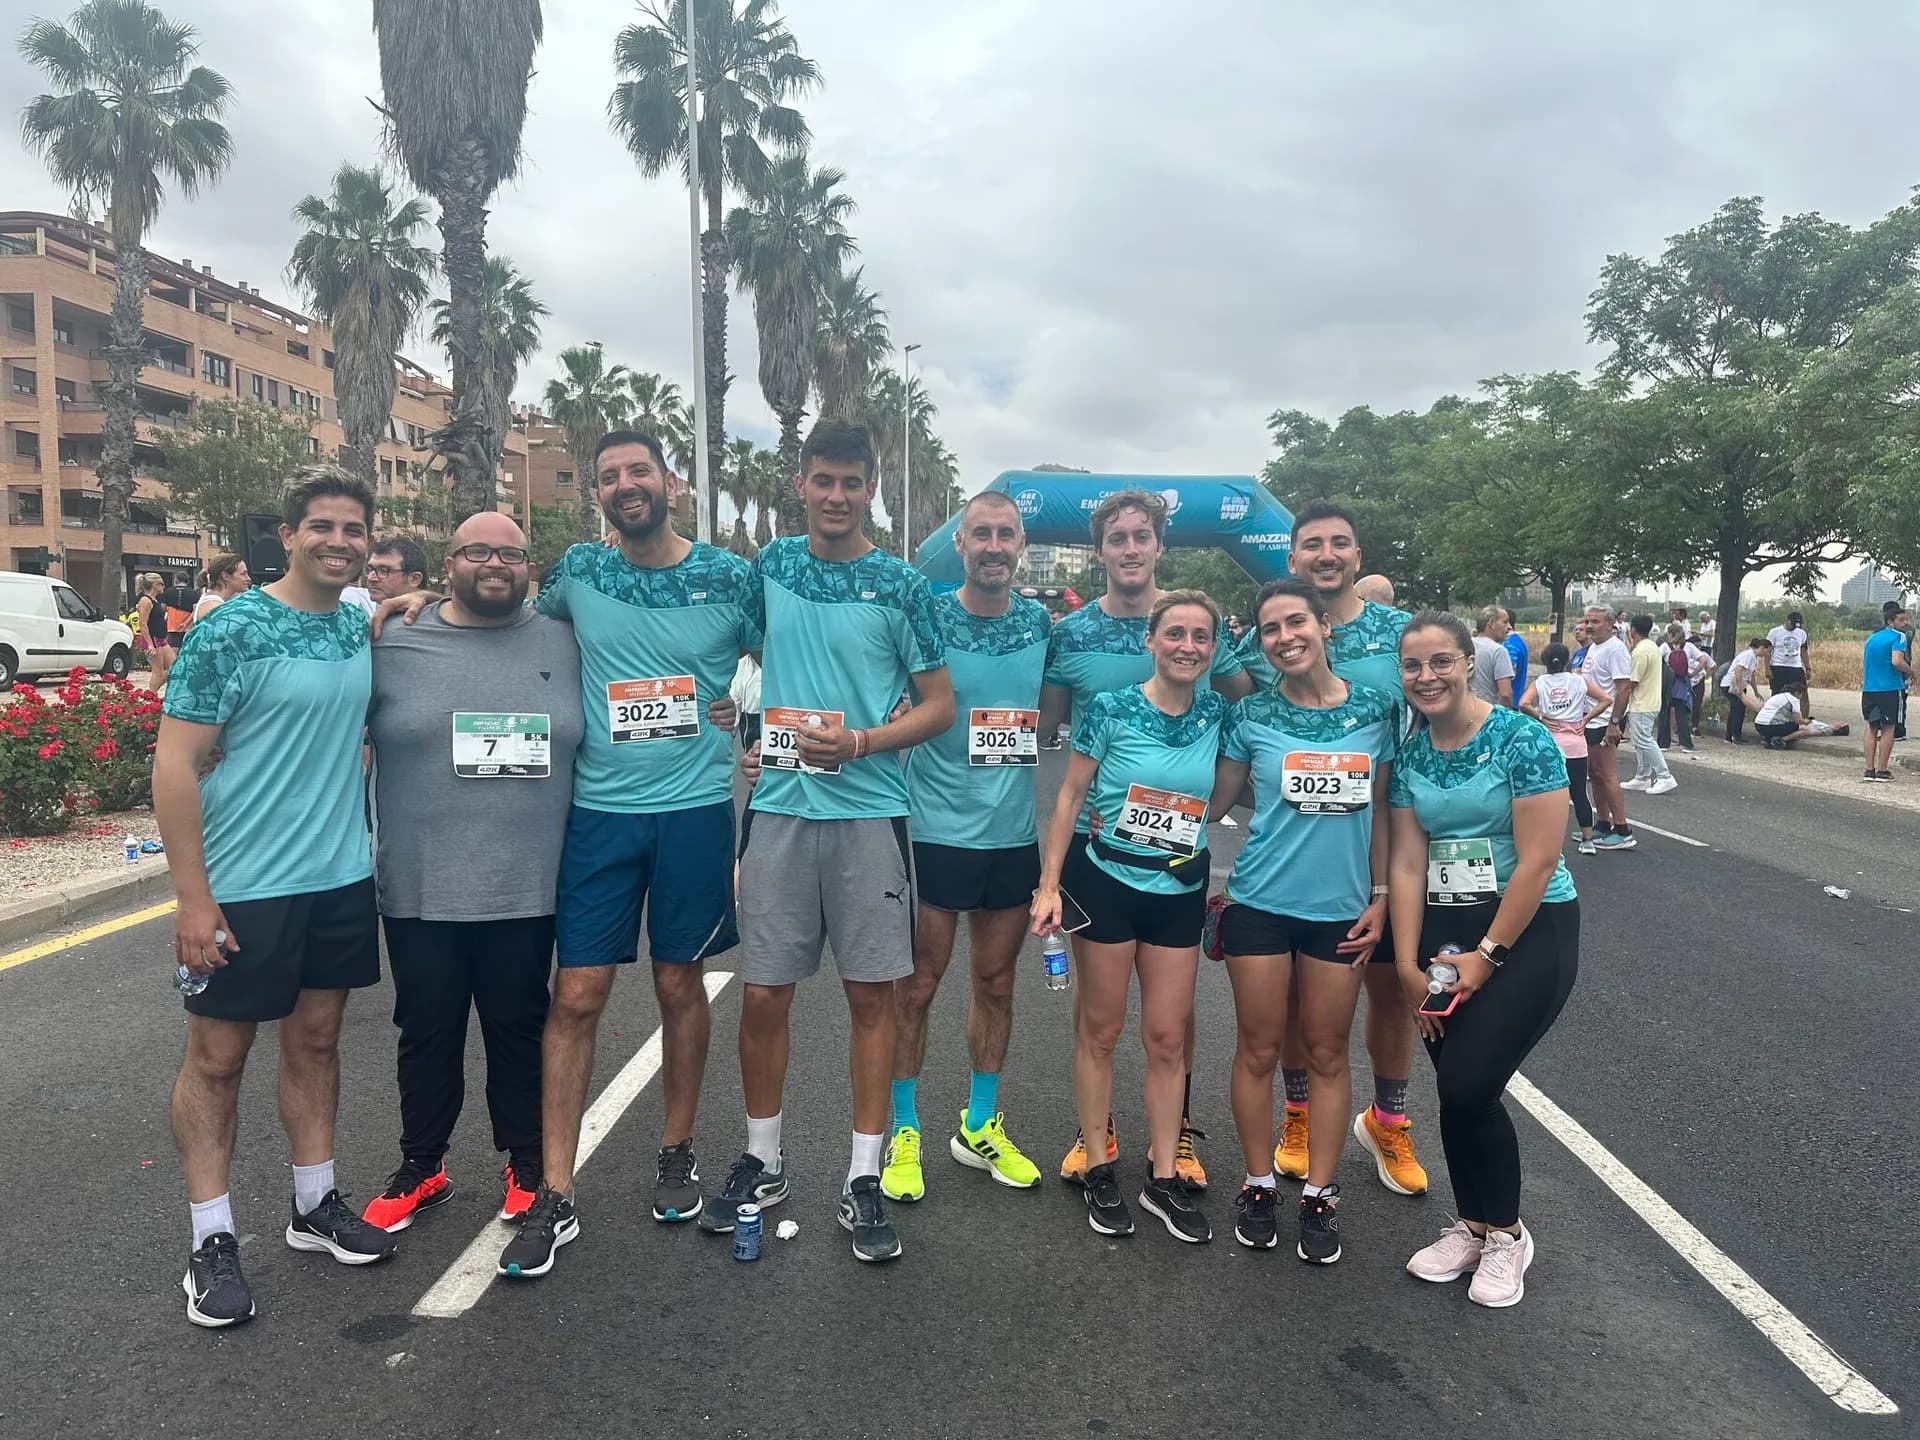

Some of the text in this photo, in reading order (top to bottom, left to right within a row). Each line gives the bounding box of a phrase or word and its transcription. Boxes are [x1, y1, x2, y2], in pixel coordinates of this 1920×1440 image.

[1220, 512, 1245, 520] SPORT
[1240, 534, 1292, 543] AMAZZIN
[617, 702, 668, 723] 3022
[530, 733, 542, 741] 5K
[768, 731, 798, 749] 302
[975, 732, 1017, 747] 3026
[483, 739, 497, 757] 7
[1289, 776, 1341, 794] 3023
[1126, 808, 1173, 832] 3024
[1440, 867, 1448, 884] 6
